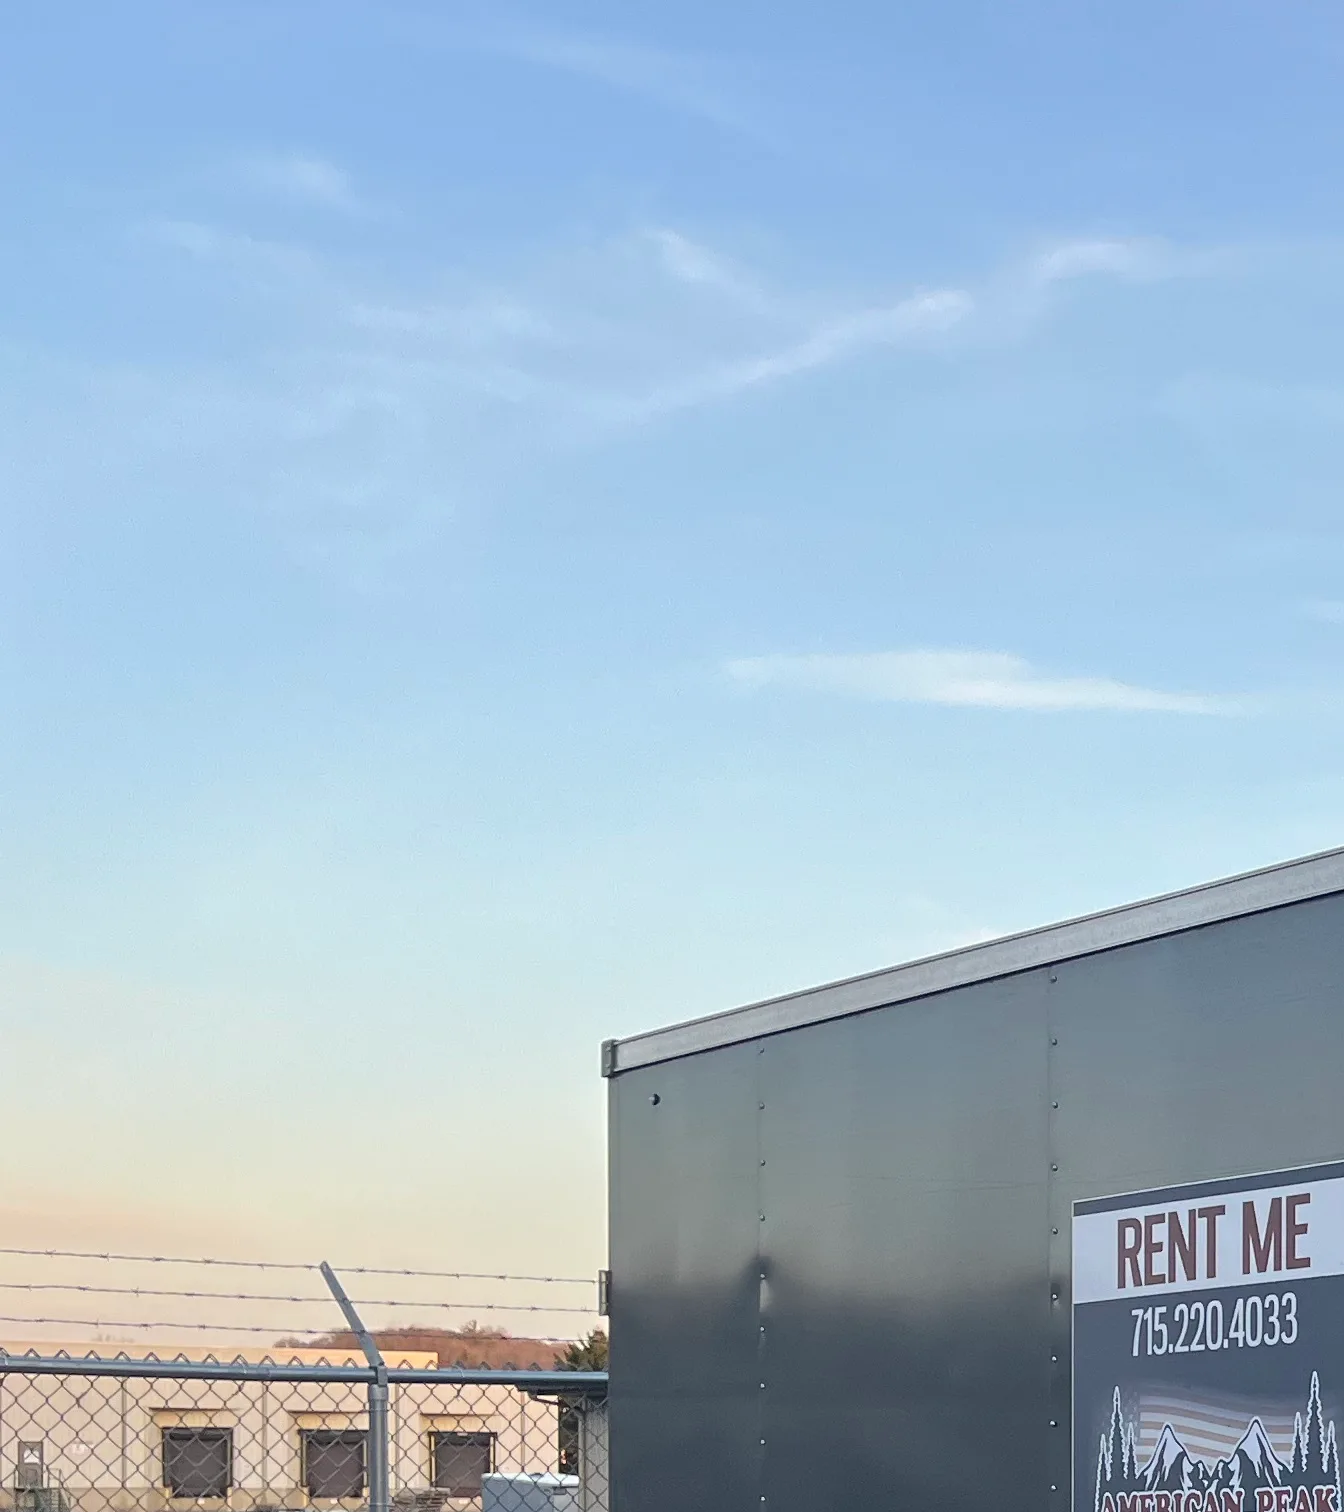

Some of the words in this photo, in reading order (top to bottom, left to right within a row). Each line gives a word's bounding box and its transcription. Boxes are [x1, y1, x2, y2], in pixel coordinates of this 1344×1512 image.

[1117, 1204, 1226, 1289] RENT
[1242, 1192, 1311, 1275] ME
[1131, 1292, 1299, 1357] 715.220.4033
